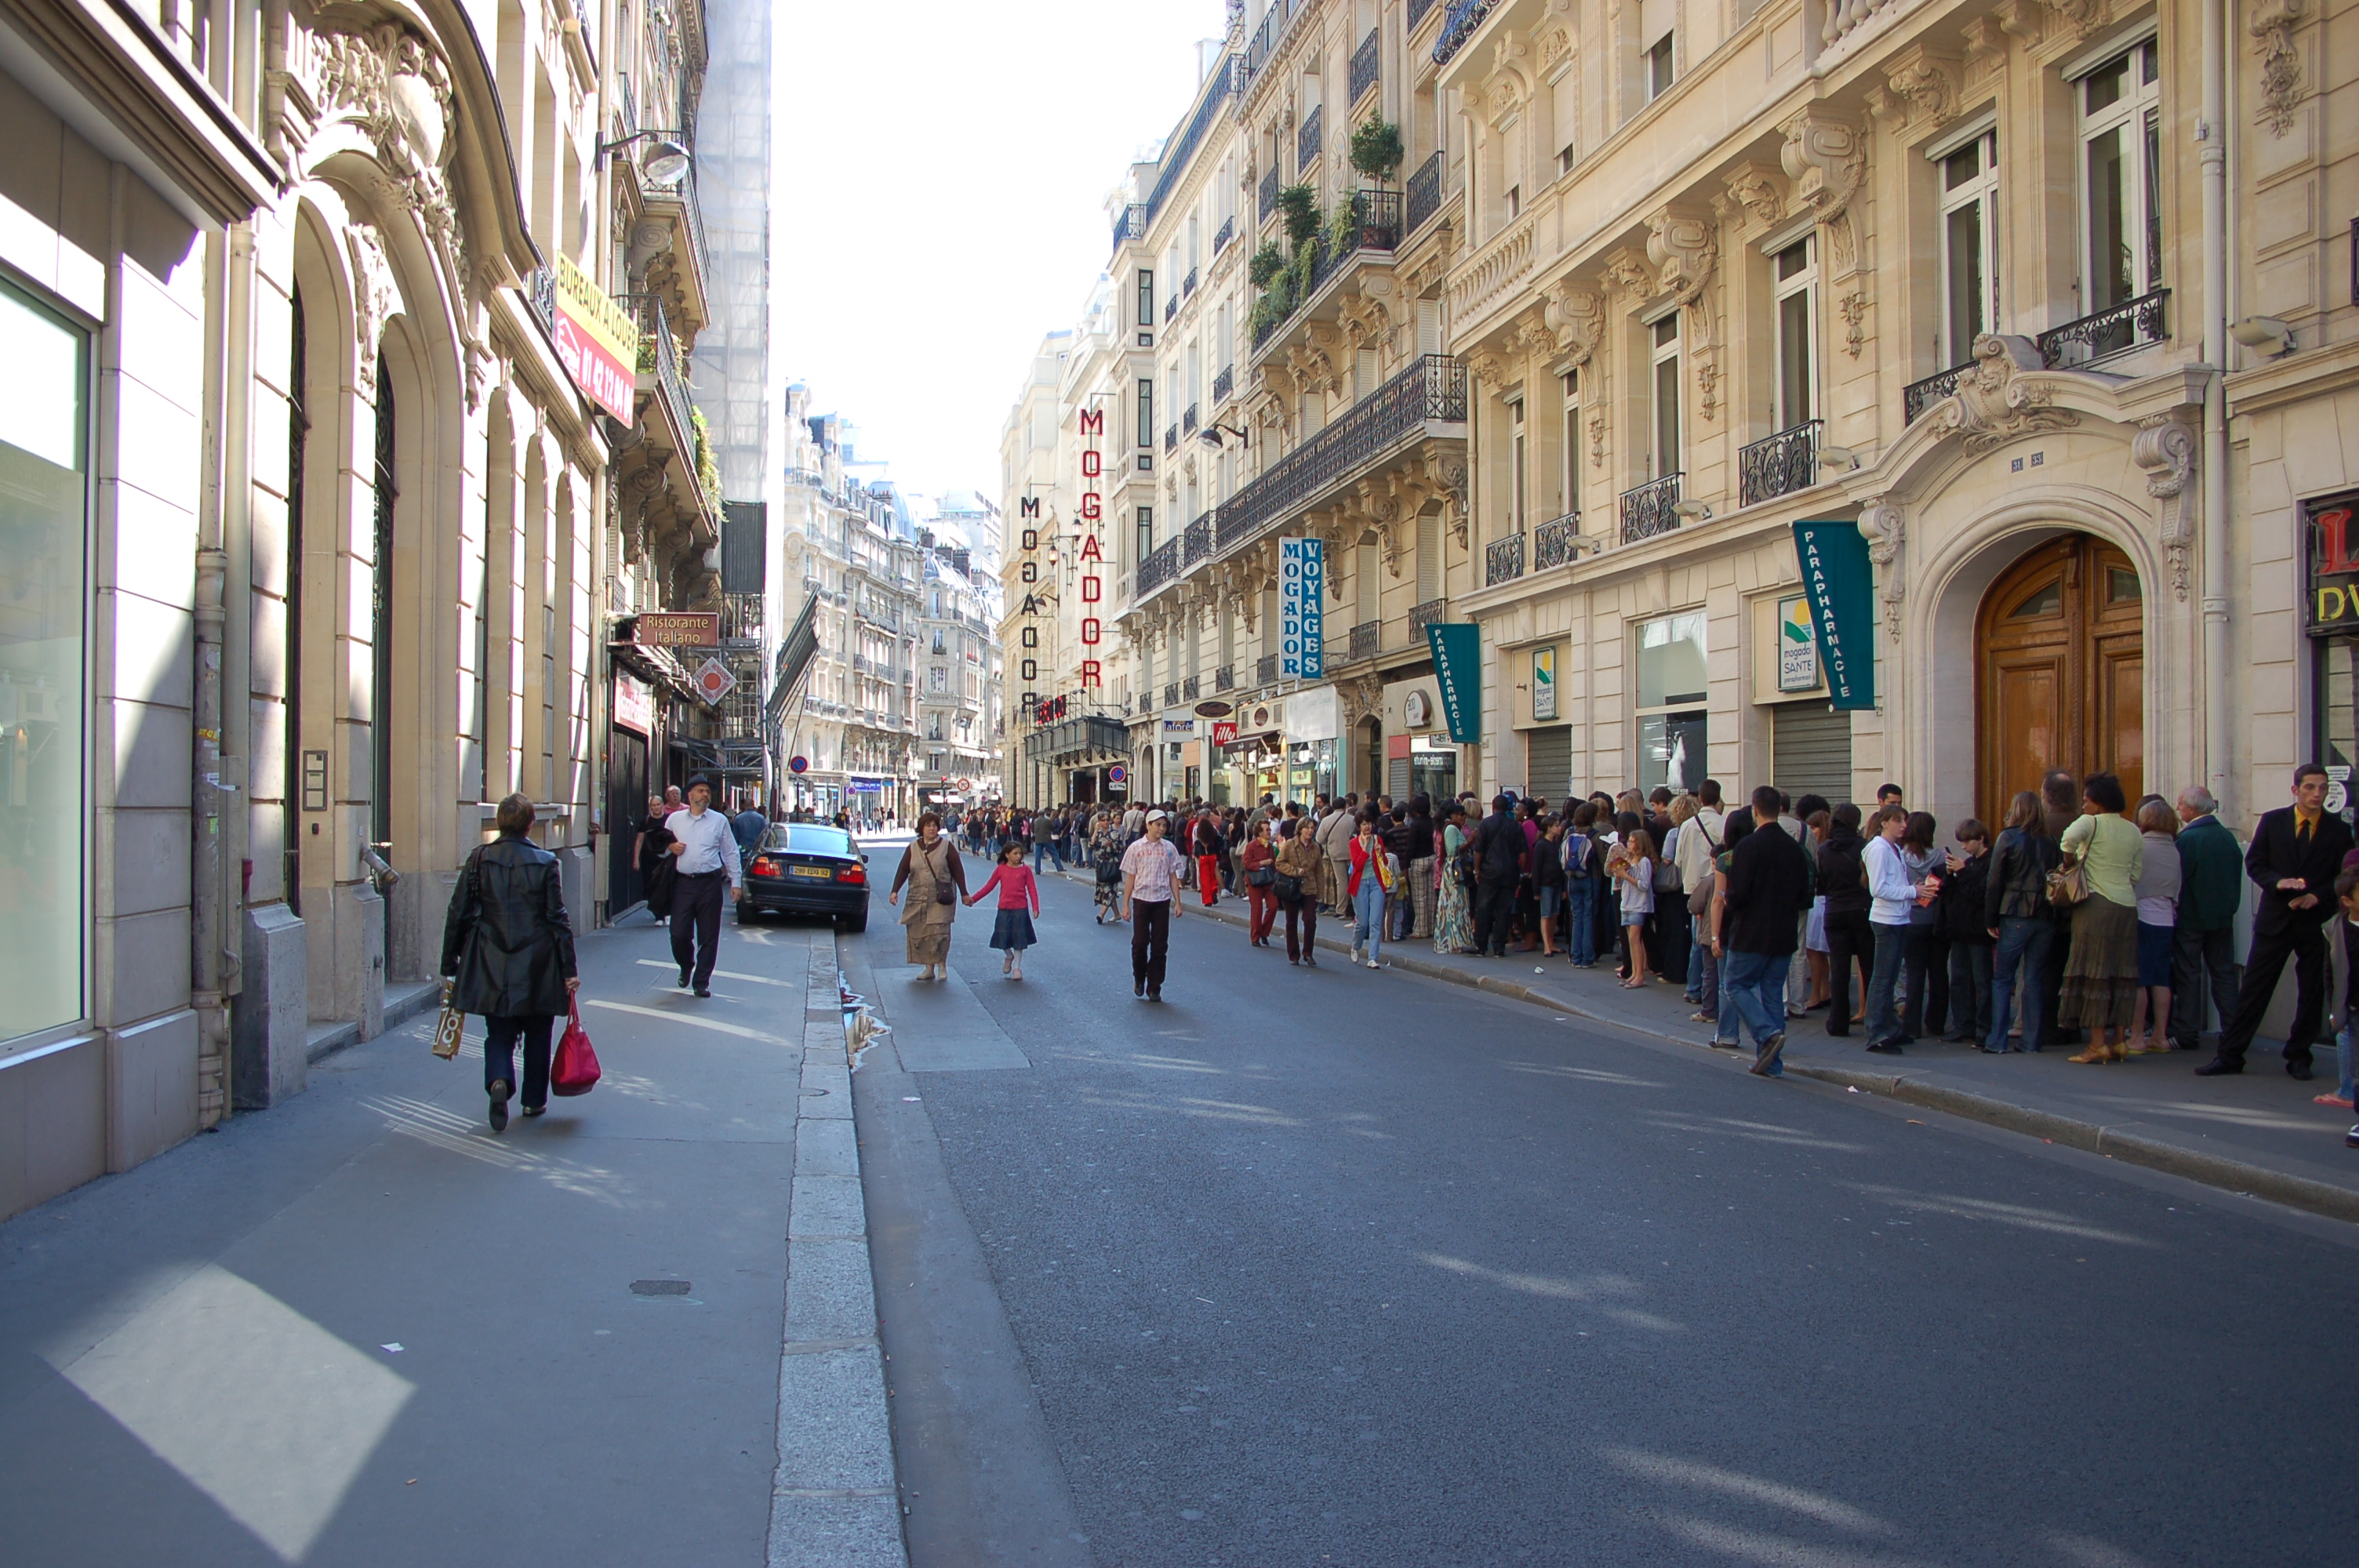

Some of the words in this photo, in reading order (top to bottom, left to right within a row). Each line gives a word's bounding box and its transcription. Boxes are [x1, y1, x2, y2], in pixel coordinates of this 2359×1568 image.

[559, 256, 602, 326] BUREAUX
[602, 301, 609, 332] A
[612, 309, 636, 356] LOUER
[583, 347, 593, 388] 01
[593, 358, 604, 397] 42
[605, 365, 614, 406] 12
[1080, 408, 1103, 688] MOGADOR
[647, 615, 709, 629] Ristorante
[655, 630, 701, 644] Italiano
[1283, 543, 1301, 674] MOGADOR
[1303, 542, 1320, 673] VOYAGES
[1805, 531, 1850, 698] PARAPHARMACIE
[1216, 726, 1236, 741] illy
[1434, 629, 1463, 735] PARAPHARMACIE
